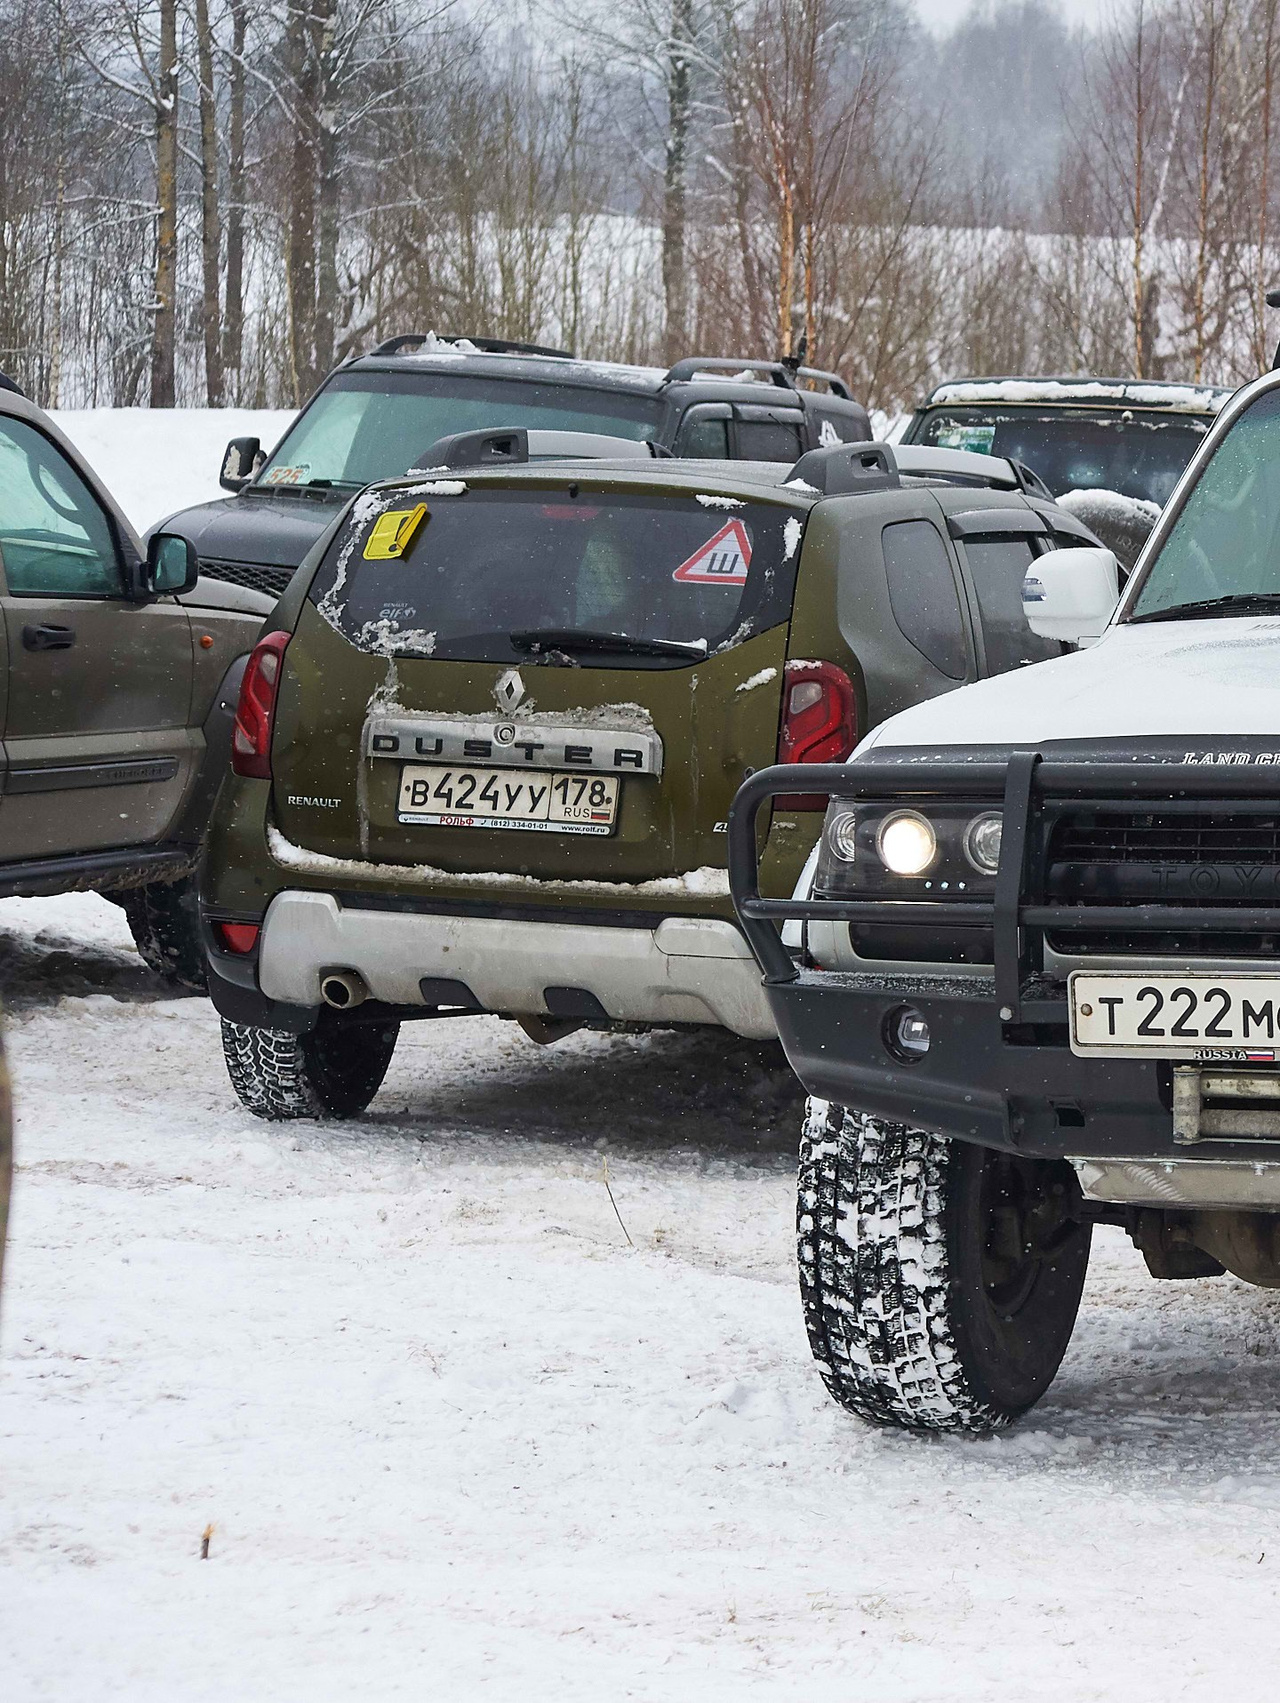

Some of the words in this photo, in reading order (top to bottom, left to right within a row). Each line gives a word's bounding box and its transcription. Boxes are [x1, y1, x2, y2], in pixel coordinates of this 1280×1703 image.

[707, 553, 739, 574] Ш
[372, 734, 643, 768] DUSTER
[1181, 752, 1251, 765] LAND
[554, 778, 605, 807] 178
[287, 795, 341, 808] RENAULT
[563, 807, 590, 818] RUS
[440, 815, 474, 826] РОЛЬФ
[490, 819, 510, 828] (812)
[511, 821, 548, 830] 334-01-01
[561, 825, 606, 834] www.rolf.ru
[1193, 1049, 1247, 1060] RUSSIA
